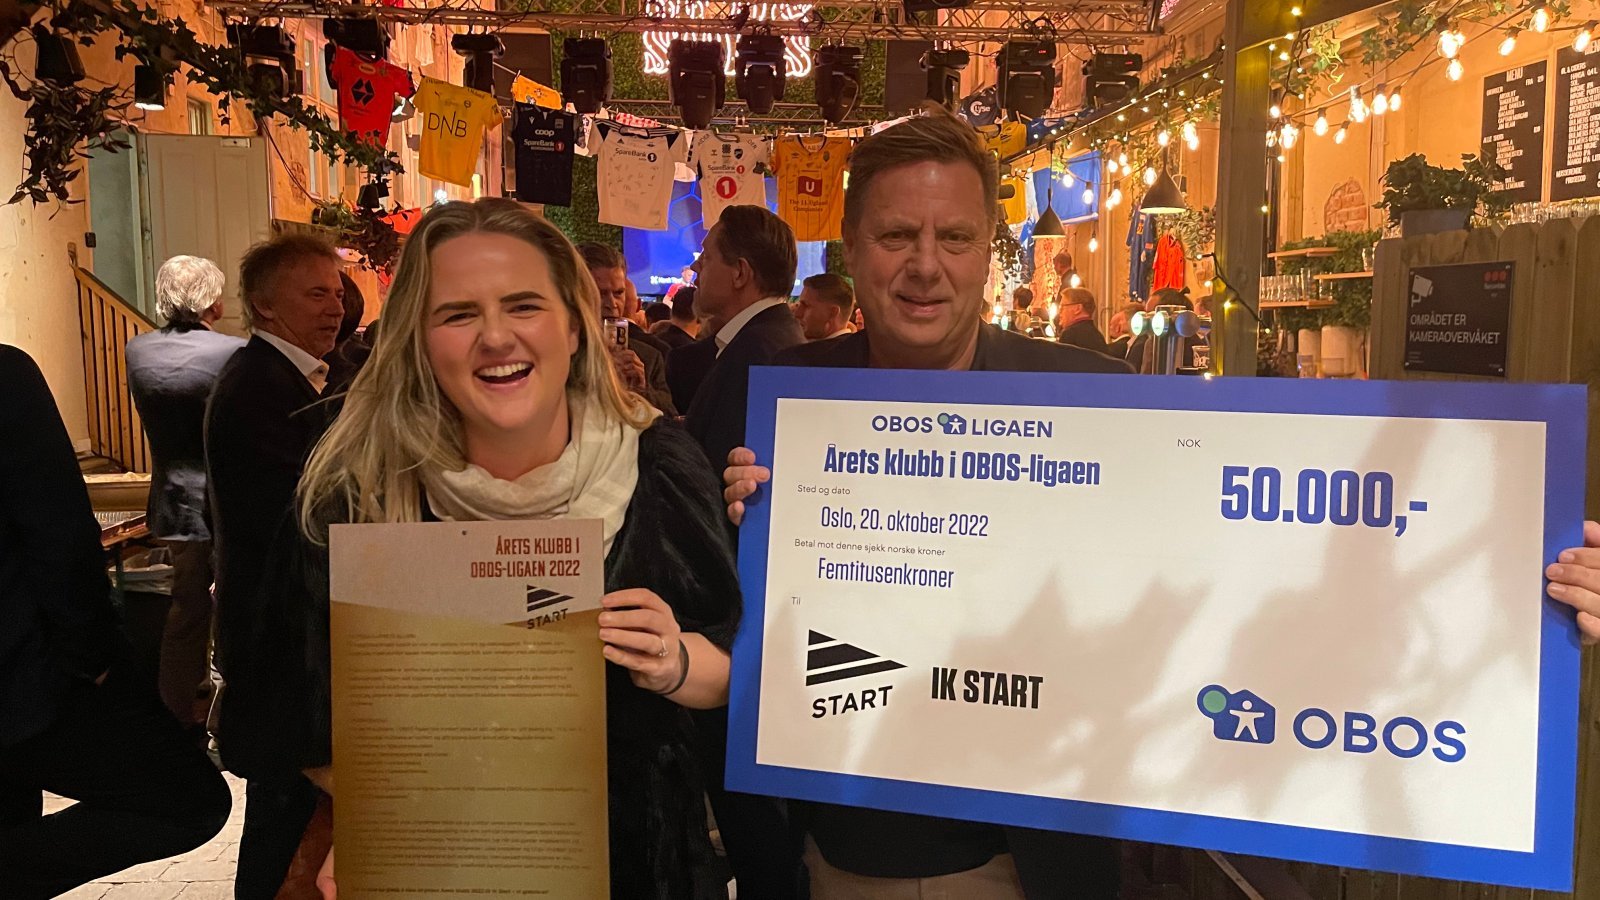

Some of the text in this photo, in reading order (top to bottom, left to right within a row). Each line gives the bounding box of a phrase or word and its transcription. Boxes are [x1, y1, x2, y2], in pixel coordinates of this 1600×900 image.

[1506, 66, 1524, 82] MENU
[428, 111, 467, 139] DNB
[534, 128, 555, 137] coop
[523, 138, 555, 147] SpareBank
[615, 148, 647, 158] SpareBank
[721, 180, 731, 195] 1
[805, 181, 815, 192] U
[1410, 313, 1466, 325] OMRÅDET ER
[1409, 328, 1500, 344] KAMERAOVERVÅKET
[872, 415, 1053, 438] OBOS LIGAEN
[1177, 438, 1201, 448] NOK
[824, 444, 1100, 487] Årets klubb i OBOS-ligaen
[797, 484, 851, 496] Sted og dato
[1221, 466, 1427, 537] 50.000,-
[821, 507, 989, 537] Oslo, 20. oktober 2022
[495, 535, 580, 555] ÅRETS KLUBB I
[794, 539, 946, 556] Betal mot denne sjekk norske kroner
[470, 559, 581, 578] OBOS-LIGAEN 2022
[818, 558, 954, 588] Femtitusenkroner
[791, 596, 801, 606] Til
[526, 608, 568, 630] START
[931, 666, 1044, 709] IK START
[811, 685, 893, 719] START
[1293, 707, 1467, 763] OBOS
